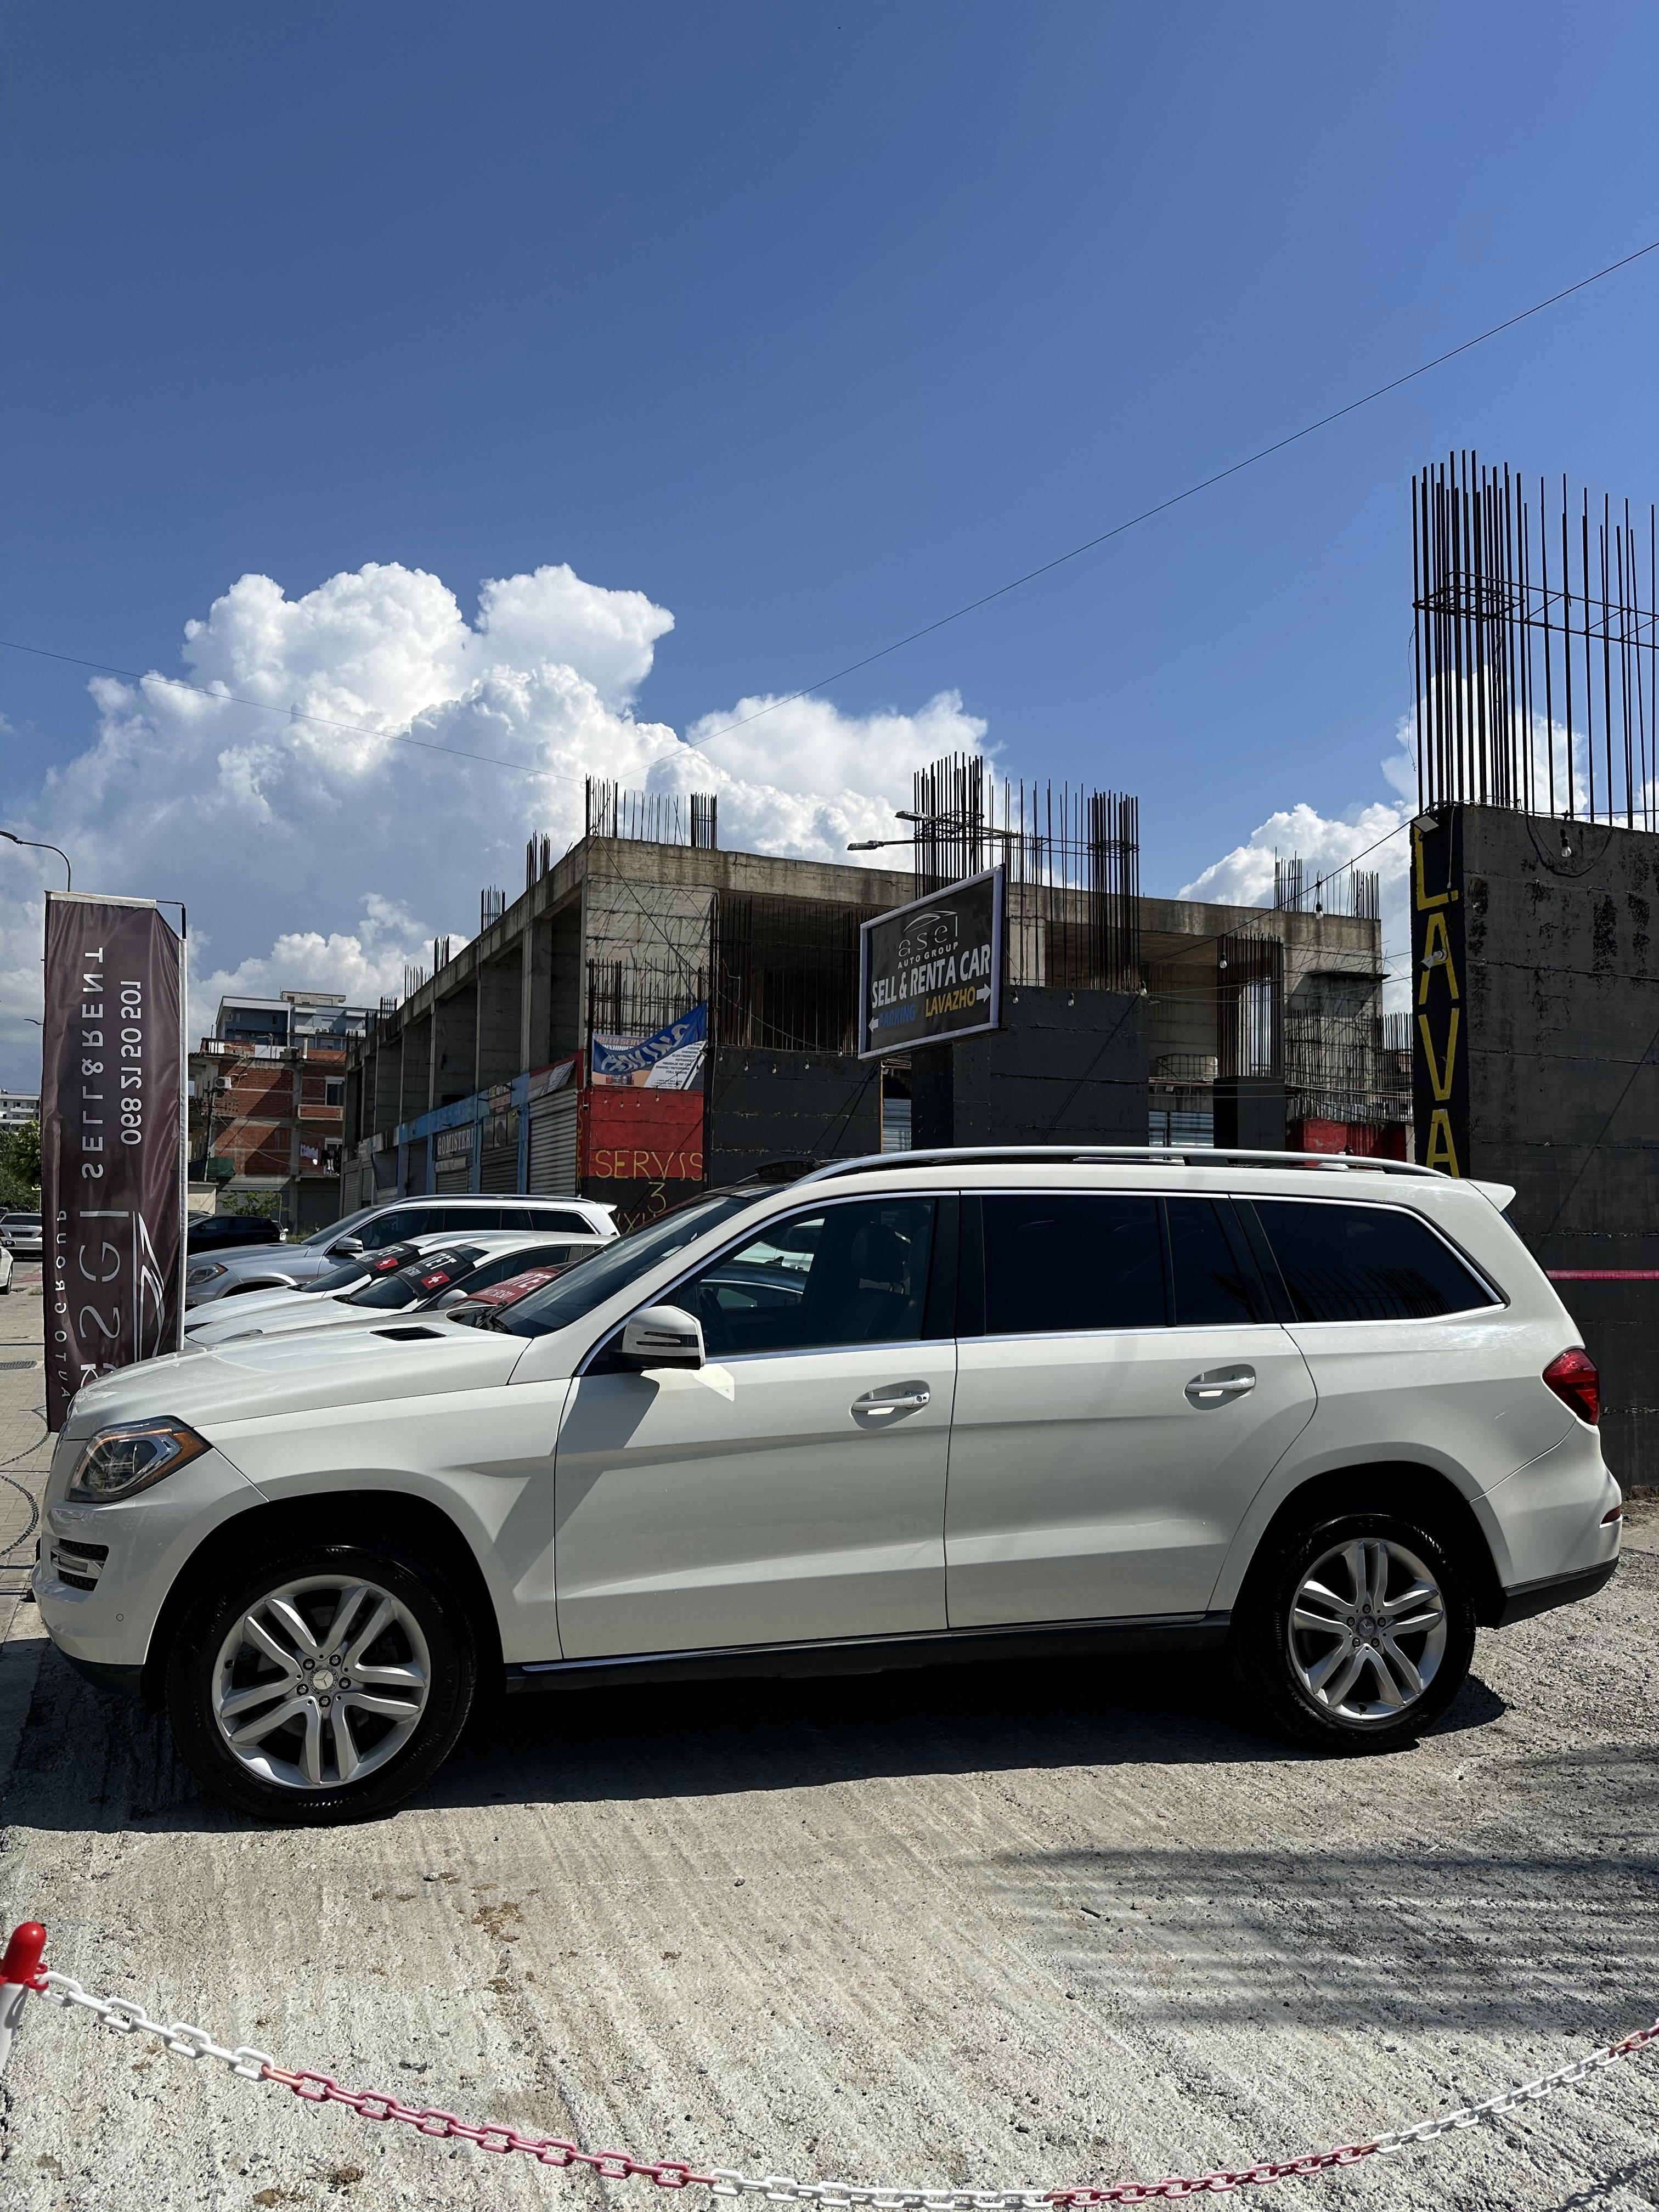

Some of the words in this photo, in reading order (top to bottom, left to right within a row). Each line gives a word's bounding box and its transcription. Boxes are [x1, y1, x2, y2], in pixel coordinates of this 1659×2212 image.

[898, 916, 958, 957] asel
[898, 955, 921, 969] AUTO
[924, 941, 958, 960] GROUP
[872, 976, 896, 1008] SELL
[899, 971, 907, 1000] &
[960, 944, 990, 981] CAR
[878, 1003, 916, 1028] PARKING
[925, 986, 976, 1017] LAVAZHO
[437, 1127, 474, 1155] GOMISTERI
[595, 1150, 703, 1181] SERVIS
[647, 1182, 667, 1214] 3
